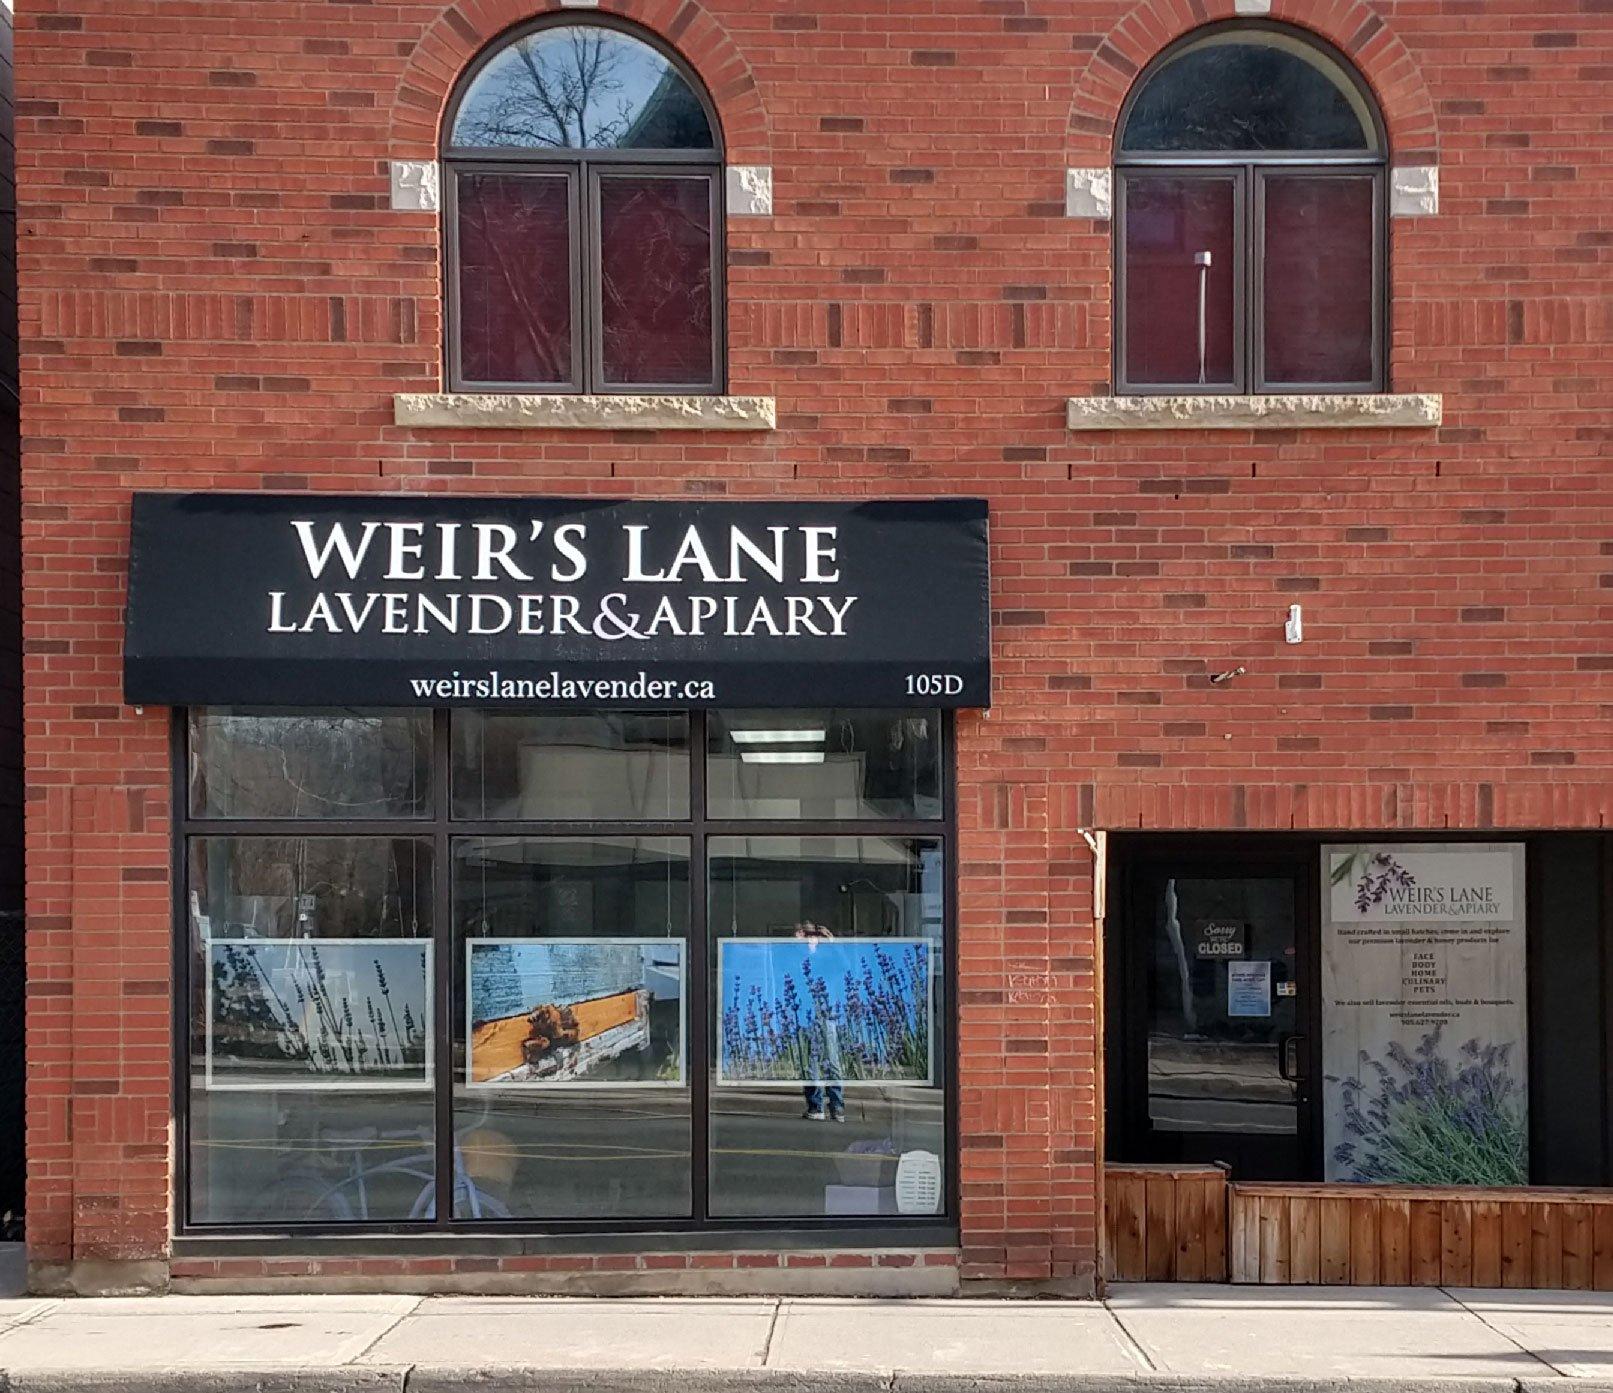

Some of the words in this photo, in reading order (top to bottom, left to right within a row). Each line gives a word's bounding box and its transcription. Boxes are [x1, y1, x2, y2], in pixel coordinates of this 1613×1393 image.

[290, 519, 587, 582] WEIR'S
[622, 524, 840, 583] LANE
[267, 591, 858, 640] LAVENDER&APIARY
[410, 671, 716, 699] weirslanelavender.ca
[905, 674, 963, 695] 105D
[1389, 886, 1445, 903] WEIR'S
[1450, 886, 1494, 903] LANE
[1384, 903, 1501, 916] LAVENDER&APIARY
[1204, 923, 1236, 939] Sorry
[1198, 942, 1242, 955] CLOSED
[1411, 961, 1436, 969] BODY
[1402, 977, 1446, 985] CULINARY
